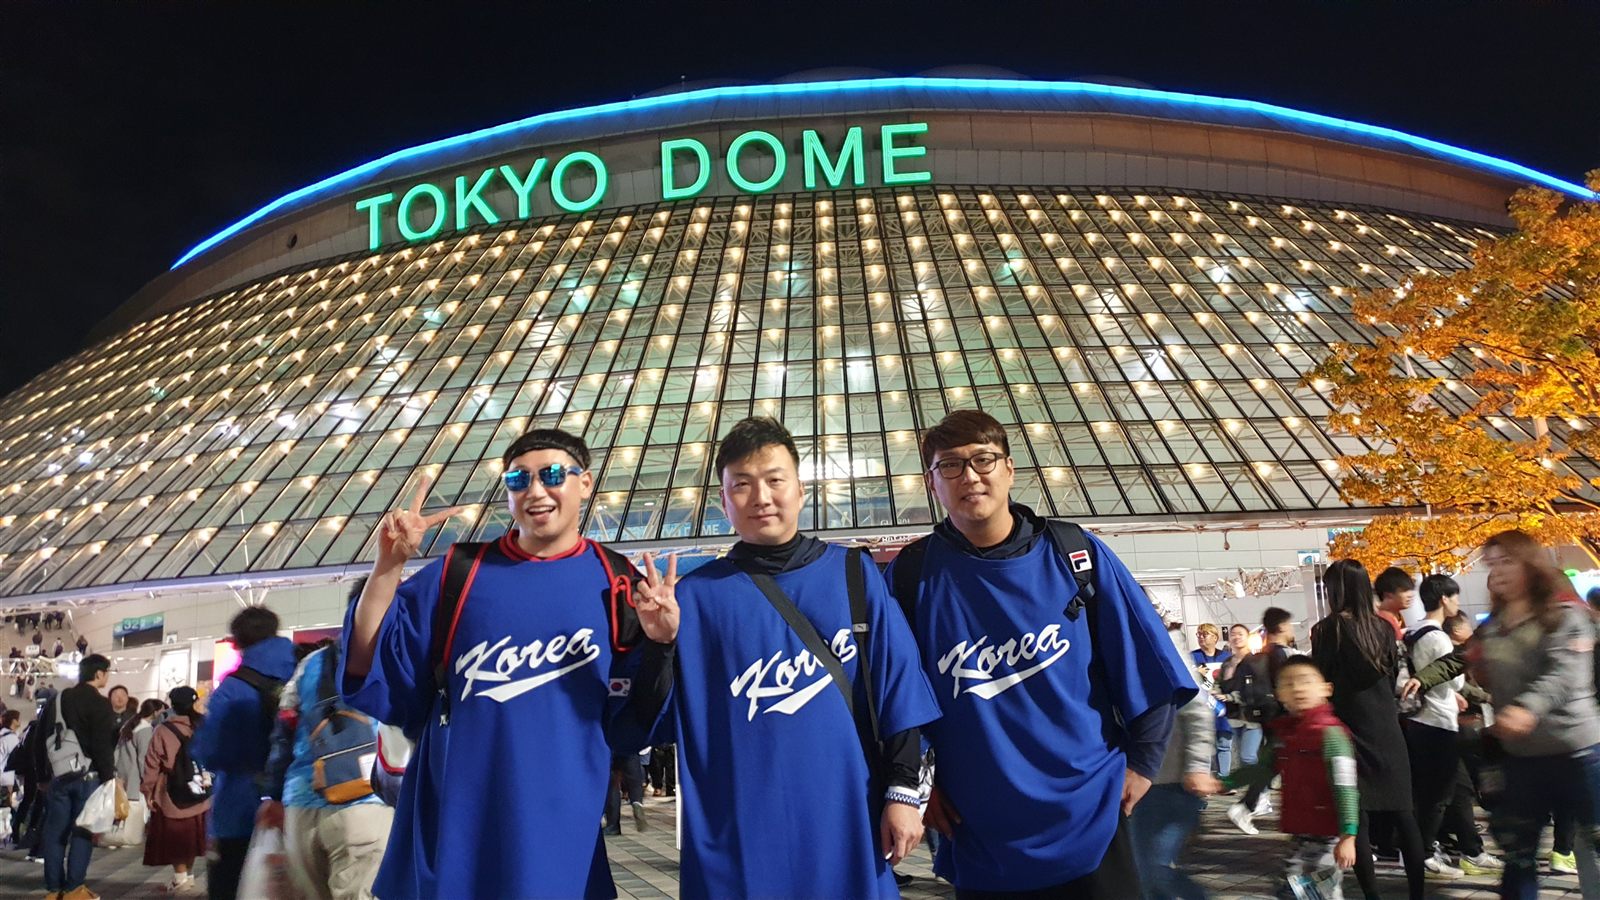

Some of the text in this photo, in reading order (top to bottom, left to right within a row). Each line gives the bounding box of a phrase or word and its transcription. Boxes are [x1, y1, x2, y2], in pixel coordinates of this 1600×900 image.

[355, 122, 932, 251] TOKYO DOME
[455, 628, 600, 702] Korea
[730, 629, 857, 722] Kora
[937, 624, 1070, 699] Korea
